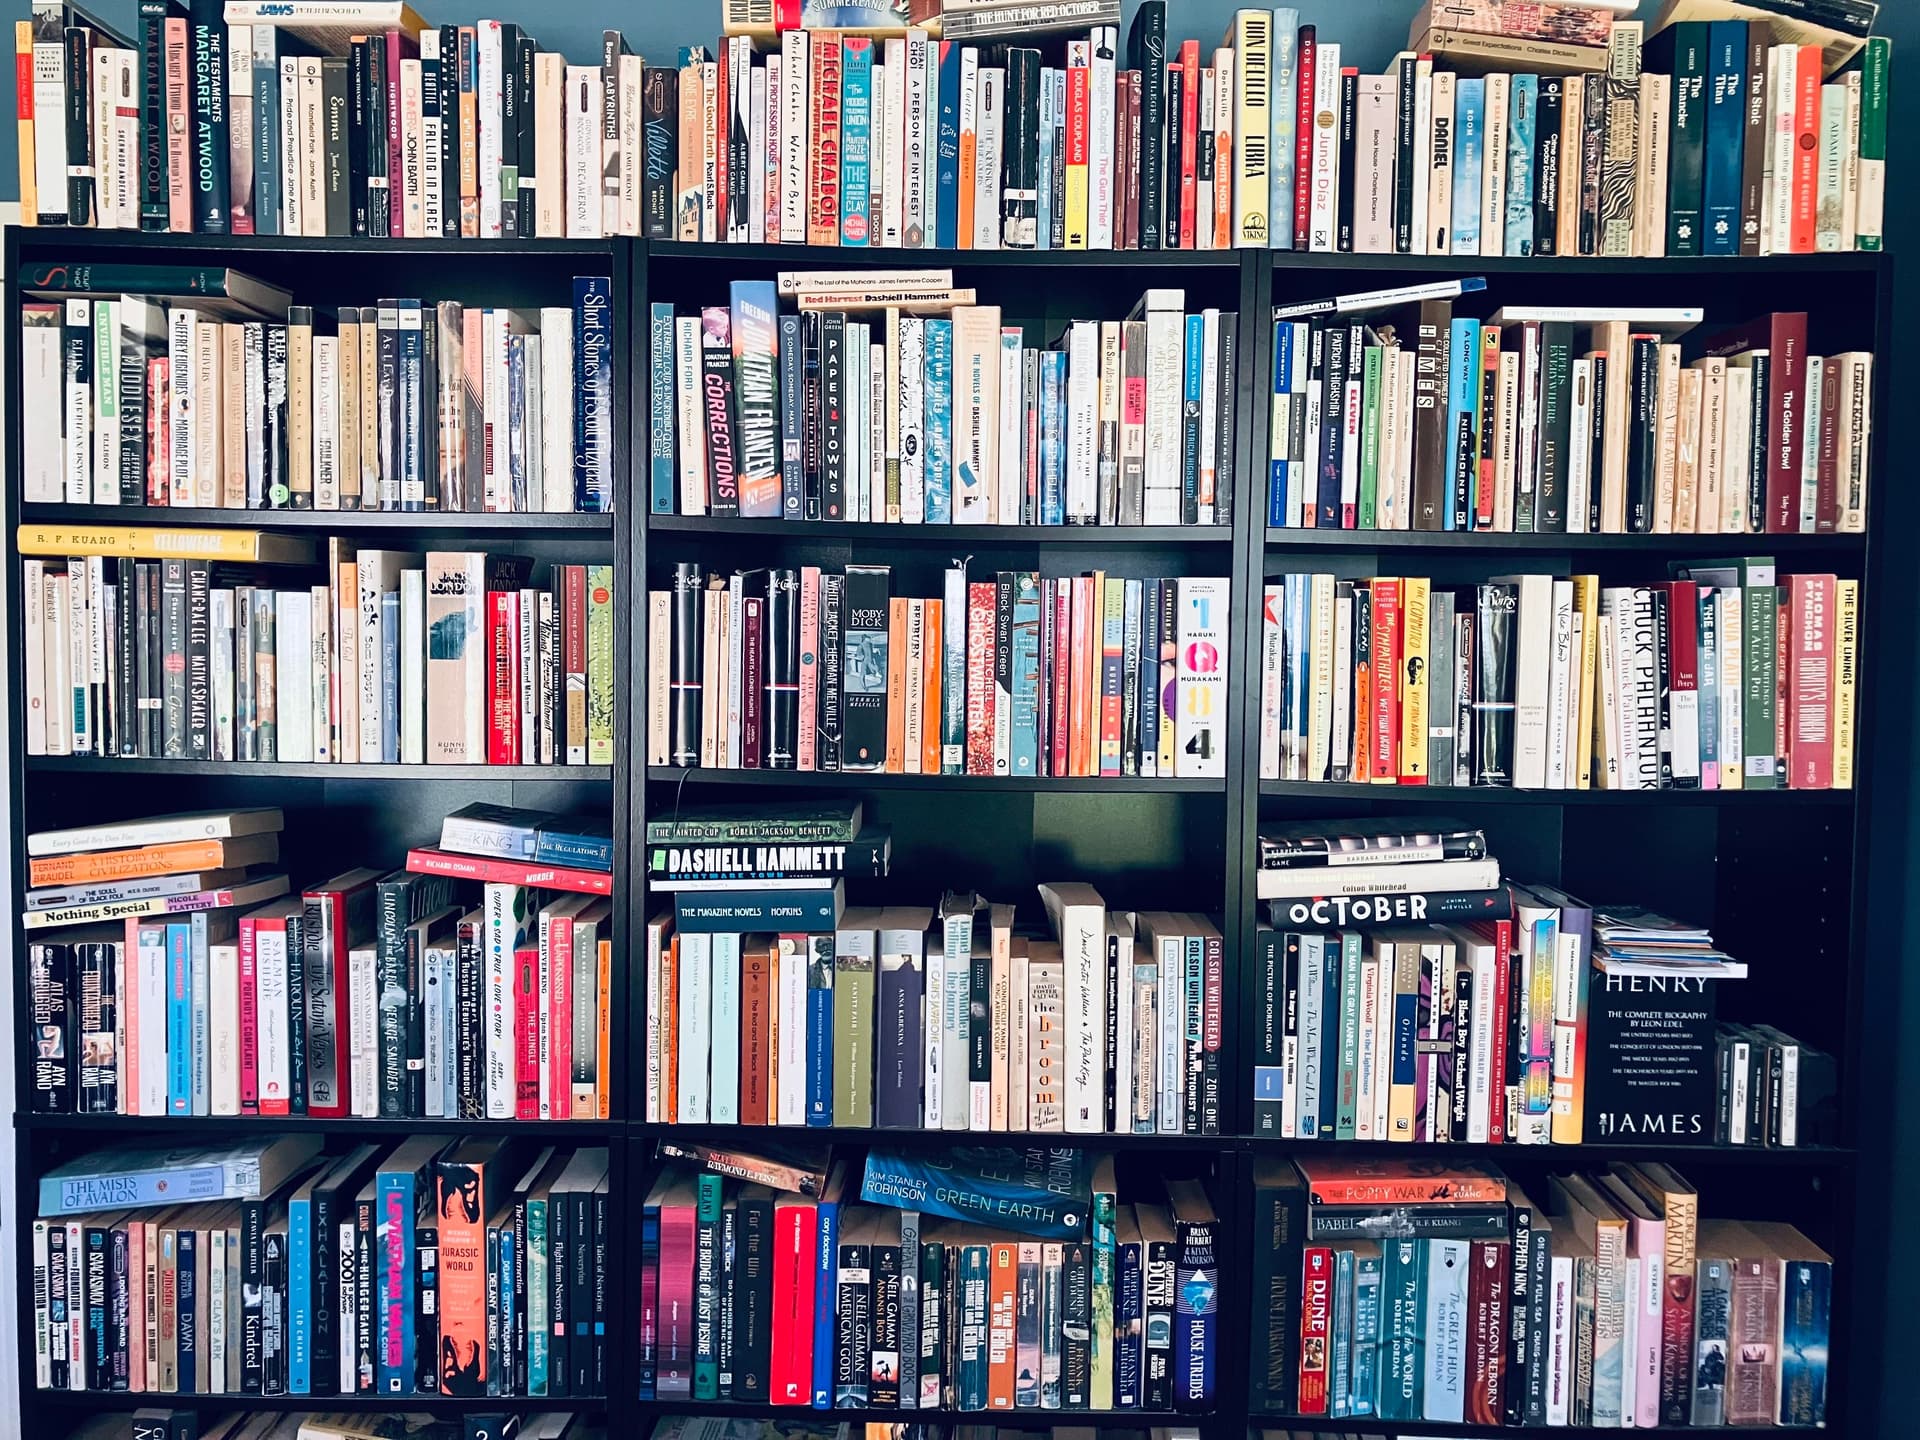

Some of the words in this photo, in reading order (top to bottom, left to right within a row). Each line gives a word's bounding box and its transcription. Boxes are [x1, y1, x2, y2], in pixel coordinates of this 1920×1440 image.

[256, 2, 294, 15] JAWS
[974, 12, 991, 23] THE
[994, 8, 1020, 22] HUNT
[1022, 6, 1040, 19] FOR
[1042, 5, 1057, 18] RED
[1058, 3, 1101, 16] OCTOBER
[211, 32, 219, 52] THE
[1246, 21, 1265, 46] DON
[196, 25, 211, 116] MARGARET
[821, 42, 839, 131] MICHAEL
[913, 80, 919, 88] A
[1691, 75, 1702, 98] The
[211, 55, 222, 123] TESTAMENTS
[1073, 72, 1082, 117] DOUGLAS
[331, 96, 344, 141] Emma
[606, 75, 615, 139] LABYRINTHS
[199, 122, 213, 192] ATWOOD
[426, 123, 436, 171] FALLING
[912, 143, 919, 157] OF
[1073, 119, 1082, 162] COUPLAND
[1246, 135, 1265, 178] LIBRA
[1435, 117, 1449, 169] DANIEL
[426, 176, 437, 189] IN
[820, 138, 838, 227] CHABON
[911, 164, 919, 217] INTEREST
[427, 194, 437, 231] PLACE
[1242, 229, 1266, 240] VIKING
[583, 294, 608, 330] Short
[805, 296, 821, 304] Red
[865, 294, 902, 302] Dashiell
[904, 292, 950, 300] Hammett
[98, 312, 110, 374] INVISIBLE
[175, 322, 188, 354] JEFFREY
[583, 332, 606, 376] Stories
[175, 355, 189, 395] EUGENIDES
[829, 340, 837, 406] PAPER
[1417, 325, 1436, 408] HIMES
[103, 377, 112, 405] MAN
[121, 354, 142, 443] MIDDLESEX
[582, 378, 600, 392] of
[1784, 391, 1792, 407] The
[1349, 389, 1357, 434] ELEVEN
[1782, 410, 1792, 445] Golden
[176, 418, 188, 458] MARRIAGE
[705, 374, 735, 498] CORRECTIONS
[175, 458, 188, 478] PLOT
[575, 439, 608, 495] Fitzgerald
[828, 426, 840, 493] TOWNS
[1782, 446, 1792, 469] Bowl
[1459, 454, 1467, 502] HORNBY
[37, 535, 48, 543] R.
[56, 536, 65, 544] F.
[72, 536, 115, 545] KUANG
[191, 570, 206, 618] CHANG-RAE
[828, 580, 838, 608] WHITE
[1001, 584, 1009, 610] Black
[1846, 587, 1854, 608] THE
[828, 612, 838, 642] JACKET
[851, 609, 884, 618] MOBY-
[851, 617, 882, 627] DICK
[1000, 614, 1008, 642] Swan
[1634, 588, 1652, 654] CHUCK
[1804, 581, 1813, 651] PYNCHON
[1845, 610, 1854, 644] SILVER
[191, 621, 206, 644] LEE
[191, 656, 206, 685] NATIVE
[1000, 646, 1008, 676] Green
[1376, 623, 1392, 692] SYMPATHIZER
[1842, 648, 1852, 685] LININGS
[191, 687, 207, 728] SPEAKER
[1636, 666, 1656, 789] PALAHNIUK
[669, 848, 752, 872] DASHIELL
[757, 846, 845, 871] HAMMETT
[33, 871, 75, 882] BRAUDEL
[45, 908, 99, 922] Nothing
[103, 902, 150, 916] Special
[681, 908, 696, 916] THE
[698, 908, 732, 916] MAGAZINE
[734, 908, 761, 916] NOVELS
[771, 907, 802, 916] HOPKINS
[1289, 894, 1427, 925] OCTOBER
[1209, 941, 1220, 982] COLSON
[49, 981, 64, 1012] ATLAS
[1606, 975, 1707, 992] HENRY
[1208, 985, 1219, 1047] WHITEHEAD
[1608, 1010, 1622, 1018] THE
[1624, 1011, 1663, 1019] COMPLETE
[1664, 1012, 1708, 1020] BIOGRAPHY
[37, 1061, 52, 1090] RAND
[51, 1066, 66, 1086] AYN
[1206, 1078, 1217, 1104] ZONE
[1206, 1108, 1216, 1128] ONE
[1609, 1114, 1702, 1134] JAMES
[69, 1181, 97, 1193] THE
[99, 1177, 137, 1190] MISTS
[866, 1181, 927, 1201] ROBINSON
[869, 1171, 886, 1181] KIM
[887, 1174, 927, 1189] STANLEY
[64, 1193, 82, 1206] OF
[84, 1189, 138, 1205] AVALON
[936, 1188, 992, 1210] GREEN
[998, 1200, 1055, 1223] EARTH
[1516, 1229, 1528, 1273] STEPHEN
[1668, 1201, 1684, 1268] MARTIN
[318, 1203, 328, 1334] EXHALATION
[441, 1247, 479, 1258] JURASSIC
[446, 1261, 474, 1271] WORLD
[875, 1280, 884, 1316] ANANSI
[887, 1275, 898, 1297] NEIL
[1148, 1262, 1164, 1306] DUNE
[1514, 1276, 1528, 1296] KING
[840, 1285, 852, 1342] AMERICAN
[857, 1294, 866, 1320] NEIL
[1311, 1279, 1325, 1332] DUNE
[181, 1314, 192, 1352] DAWN
[876, 1319, 884, 1343] BOYS
[886, 1301, 898, 1348] GAIMAN
[1191, 1320, 1204, 1350] HOUSE
[246, 1315, 260, 1369] Kindred
[856, 1324, 865, 1372] GAIMAN
[839, 1346, 851, 1381] GODS
[1190, 1354, 1204, 1400] ATREIDES
